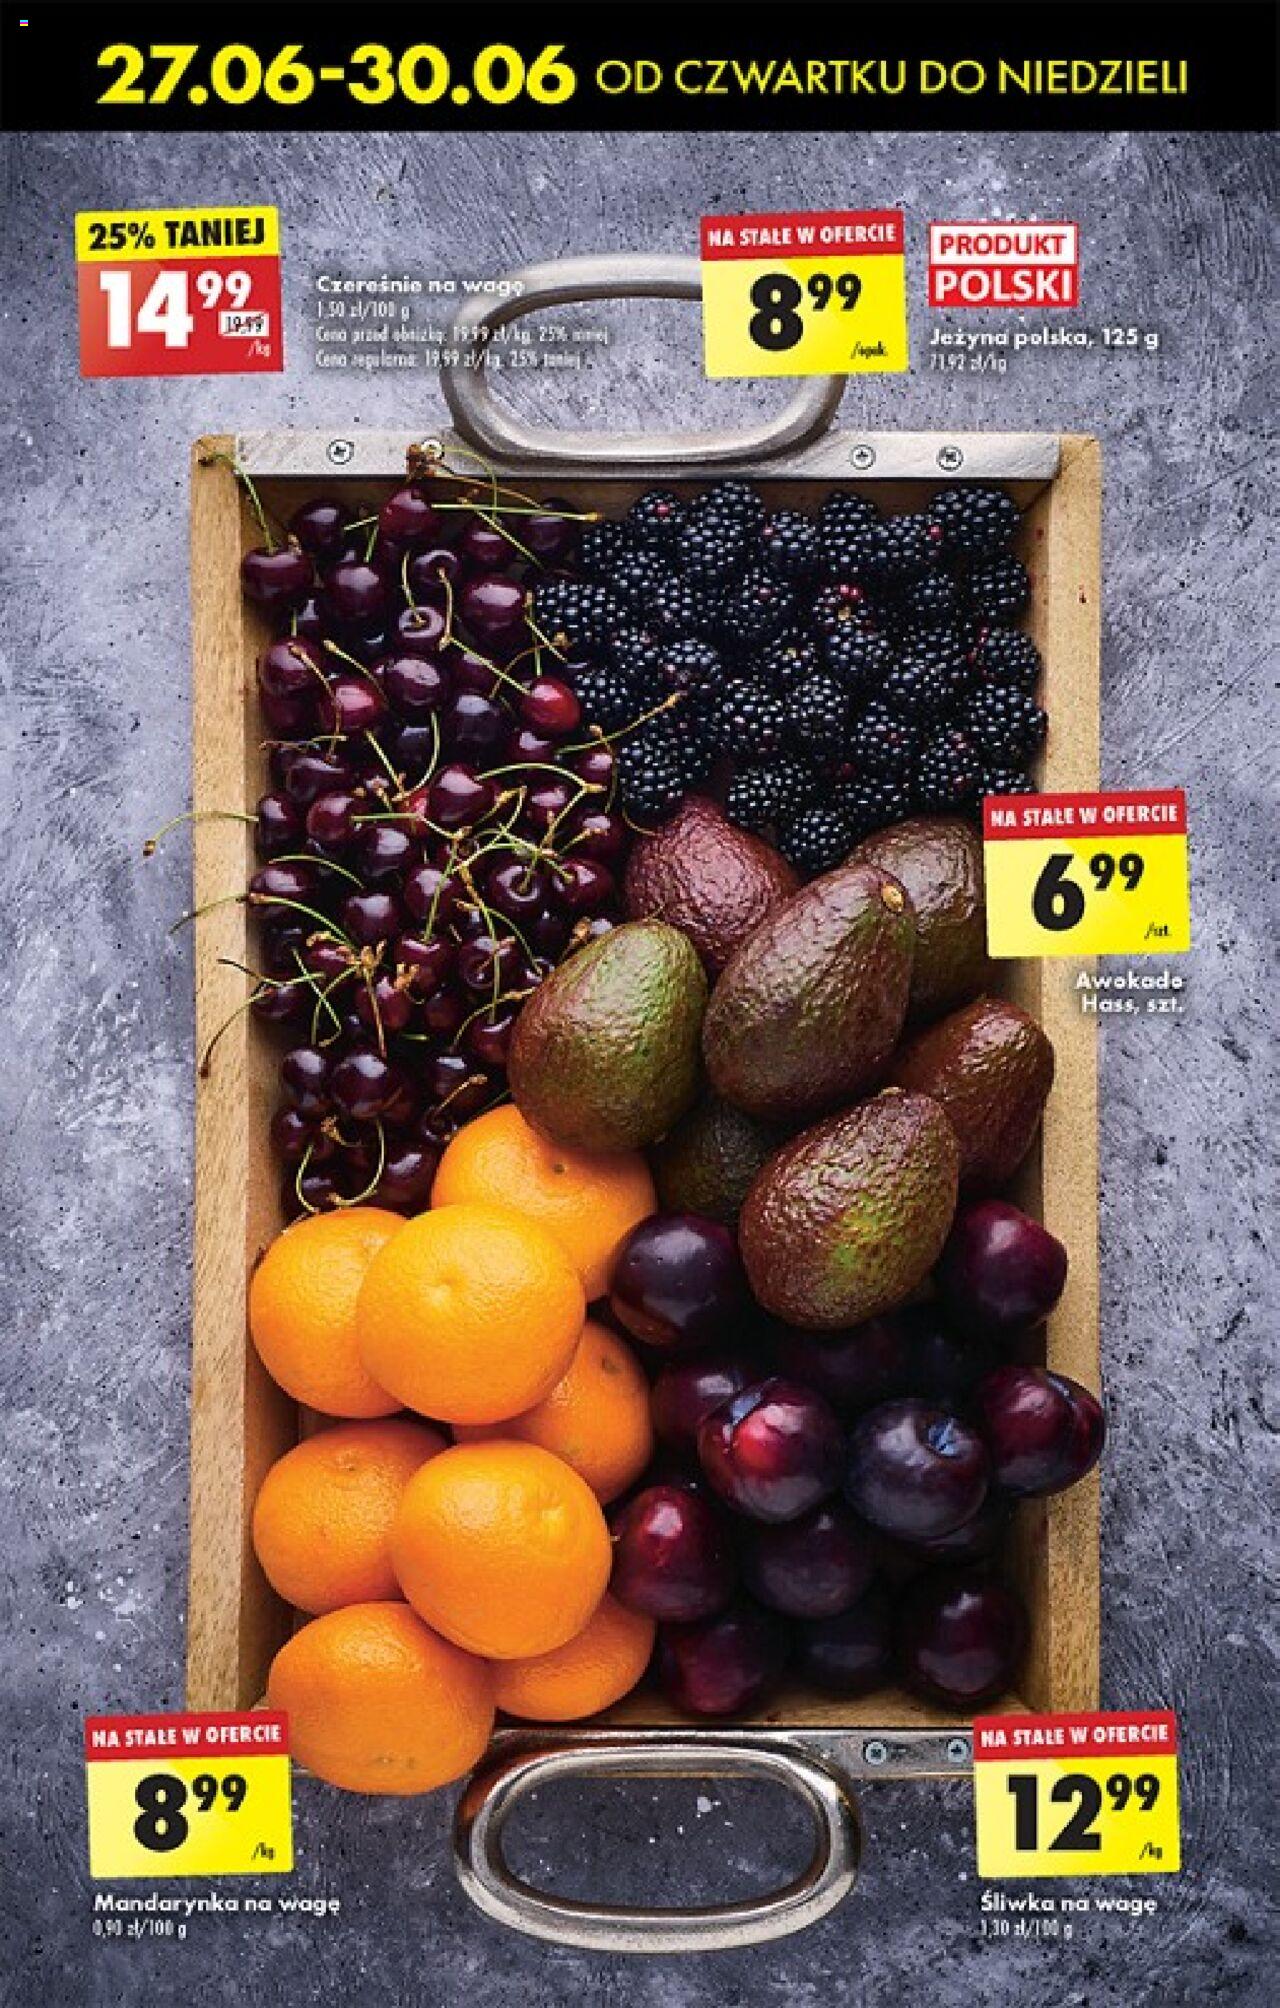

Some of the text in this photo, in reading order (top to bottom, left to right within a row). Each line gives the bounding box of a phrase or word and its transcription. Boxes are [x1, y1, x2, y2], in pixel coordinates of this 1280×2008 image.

[97, 44, 577, 104] 27.06-30.06
[597, 60, 1188, 93] OD CZWARTKU DO NIEDZIELI
[89, 218, 265, 250] 25% TANIEJ
[708, 231, 735, 247] NA
[797, 227, 815, 244] W
[820, 223, 897, 243] OFERCIE
[940, 234, 1067, 255] PRODUKT
[316, 276, 524, 296] Czereśnie na wagę
[935, 270, 1073, 301] POLSKI
[401, 305, 410, 319] g
[315, 326, 347, 342] Cena
[353, 326, 388, 343] przed
[539, 326, 567, 342] 25%
[573, 326, 608, 344] mniej
[930, 327, 1159, 349] Jeżyna polska, 125 g
[315, 350, 347, 367] Cena
[510, 350, 538, 367] 25%
[991, 811, 1017, 827] NA
[1079, 808, 1097, 824] W
[1103, 805, 1178, 823] OFERCIE
[1076, 970, 1183, 990] Awokado
[1082, 994, 1185, 1014] Hass, szt.
[91, 1730, 120, 1747] NA
[182, 1727, 201, 1744] W
[206, 1724, 282, 1743] OFERCIE
[980, 1730, 1007, 1747] NA
[1071, 1727, 1088, 1743] W
[1093, 1724, 1169, 1743] OFERCIE
[93, 1892, 341, 1916] Mandarynka na wagę
[981, 1889, 1158, 1916] Śliwka na wagę
[178, 1924, 187, 1939] g
[1063, 1924, 1073, 1940] g
